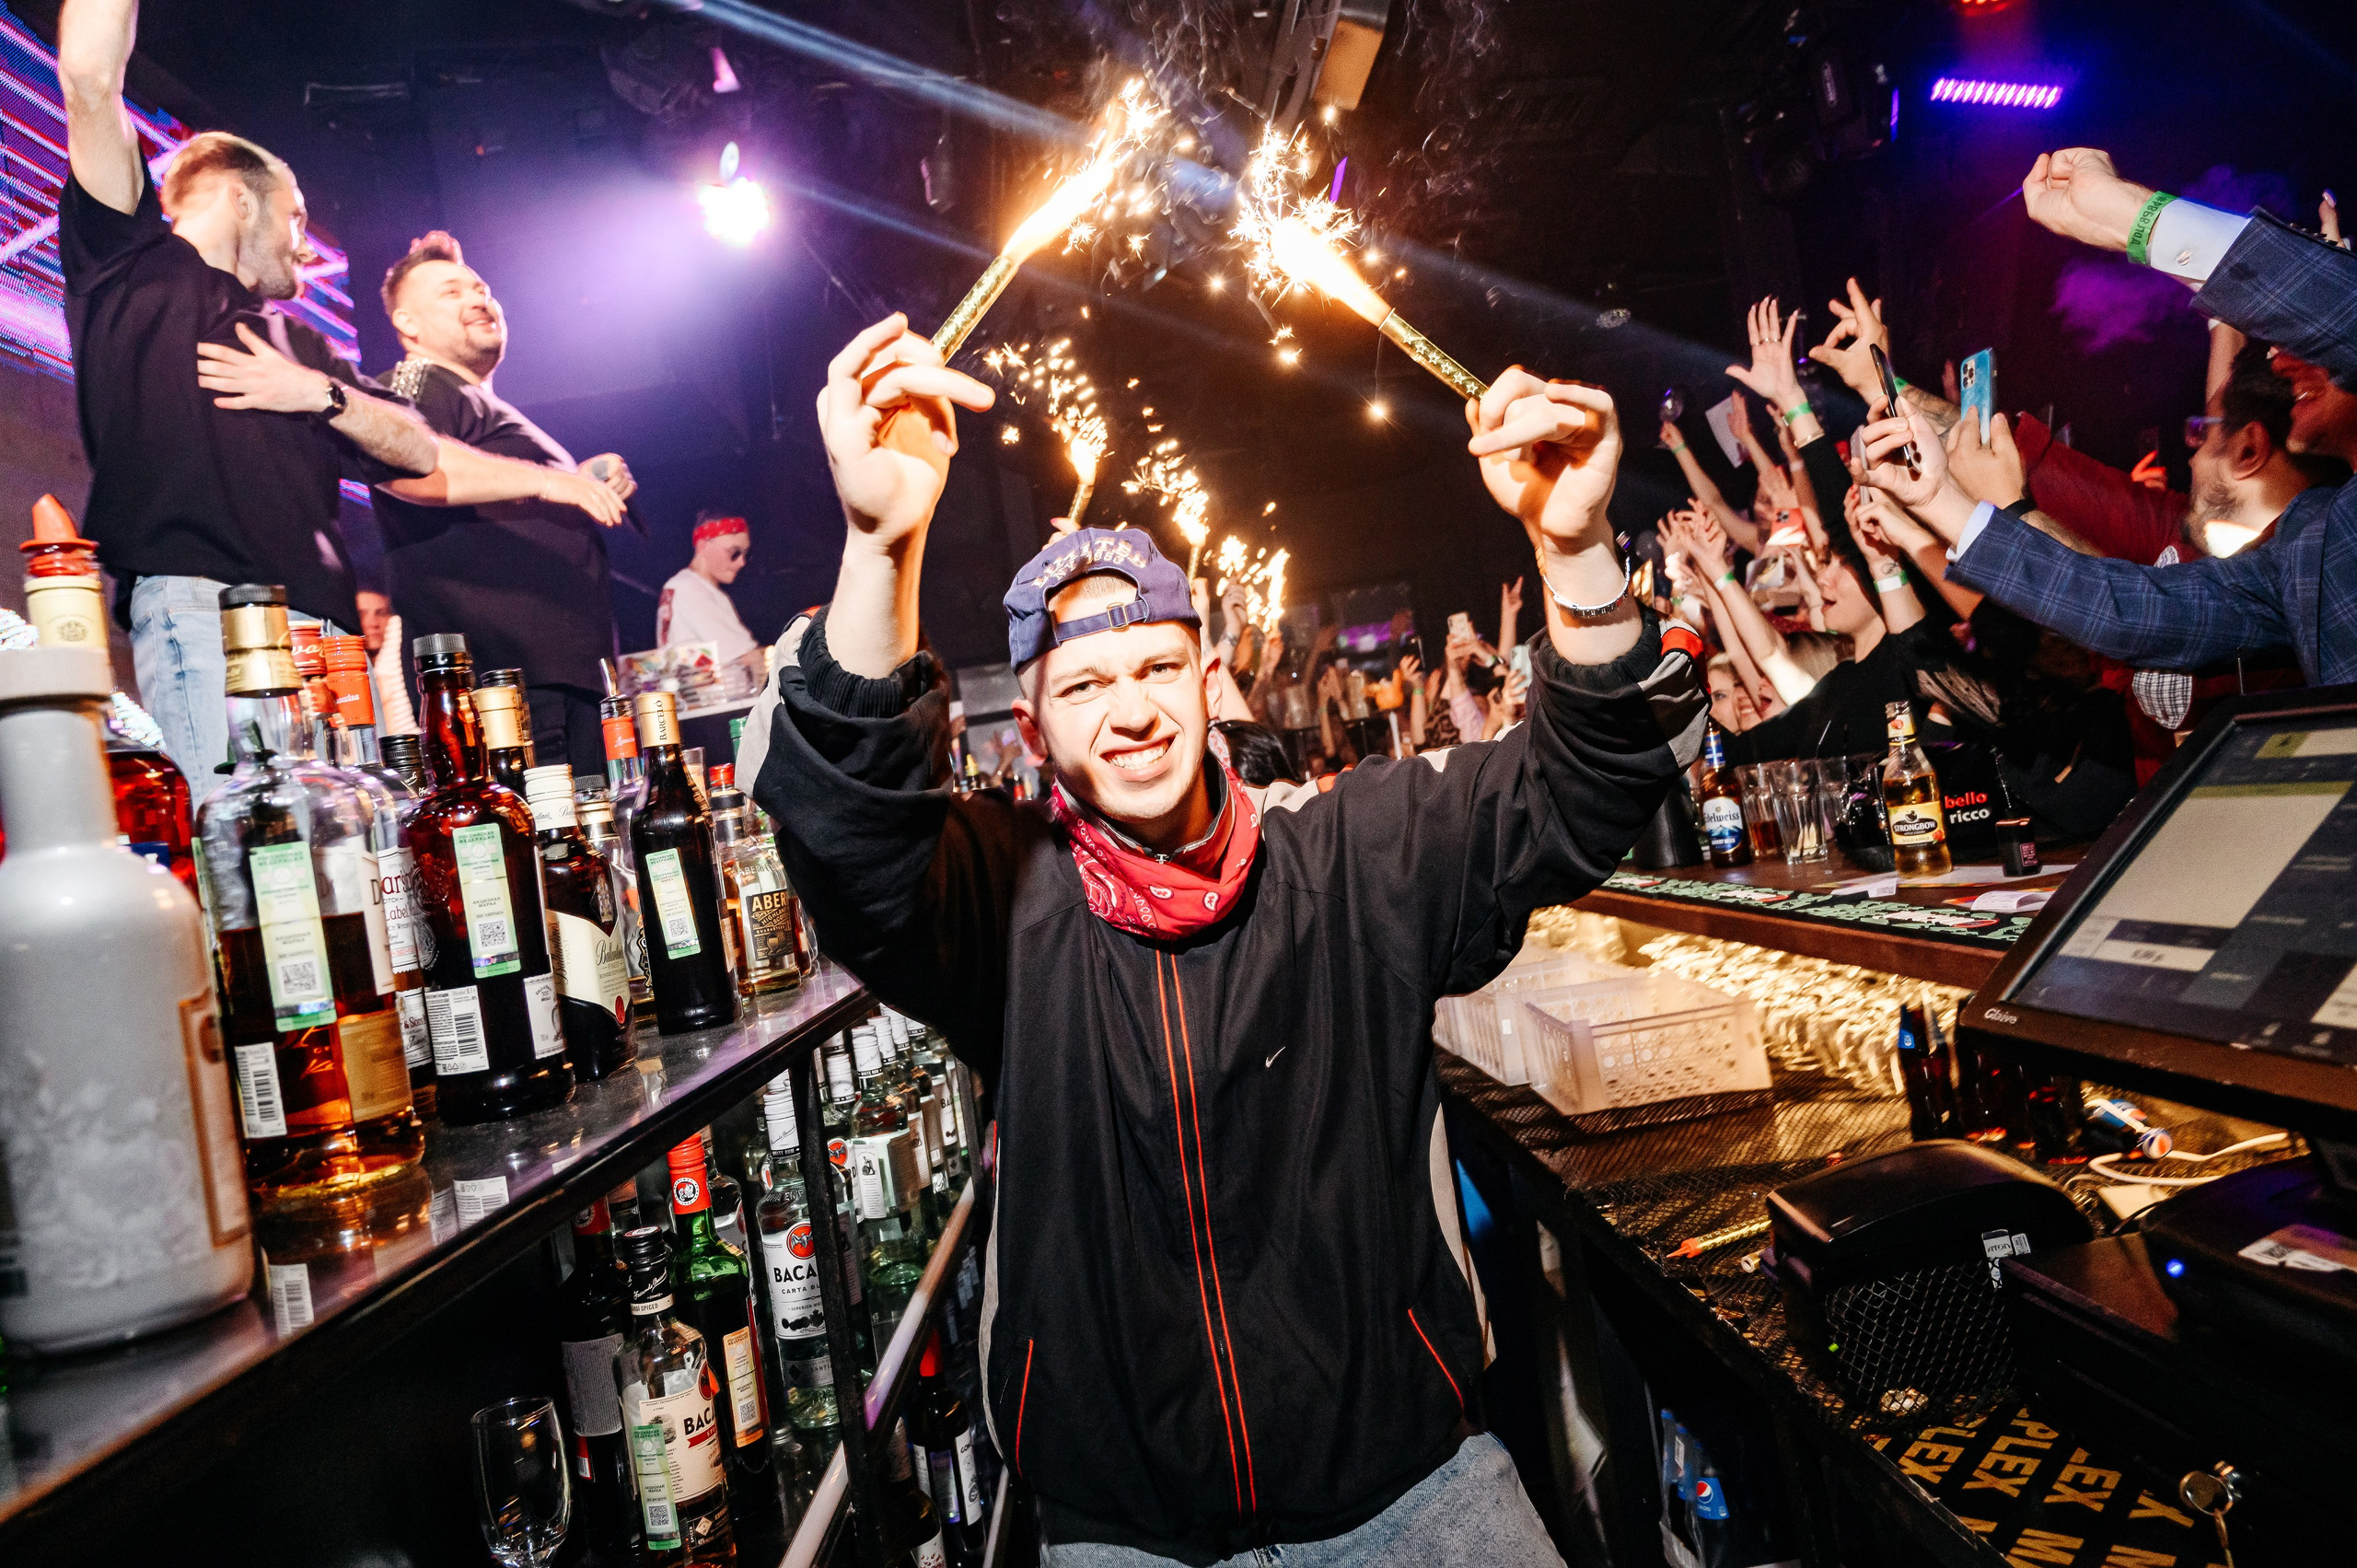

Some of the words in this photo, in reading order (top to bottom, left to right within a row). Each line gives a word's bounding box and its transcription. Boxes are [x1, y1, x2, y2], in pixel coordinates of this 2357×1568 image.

[655, 700, 668, 740] BARCELÓ
[1945, 792, 1988, 809] bello
[1949, 808, 1991, 824] ricco
[1894, 821, 1936, 832] STRONGBOW
[782, 1285, 807, 1295] CARTA
[641, 1303, 659, 1312] SPICED
[1962, 1407, 2060, 1498] PLEX
